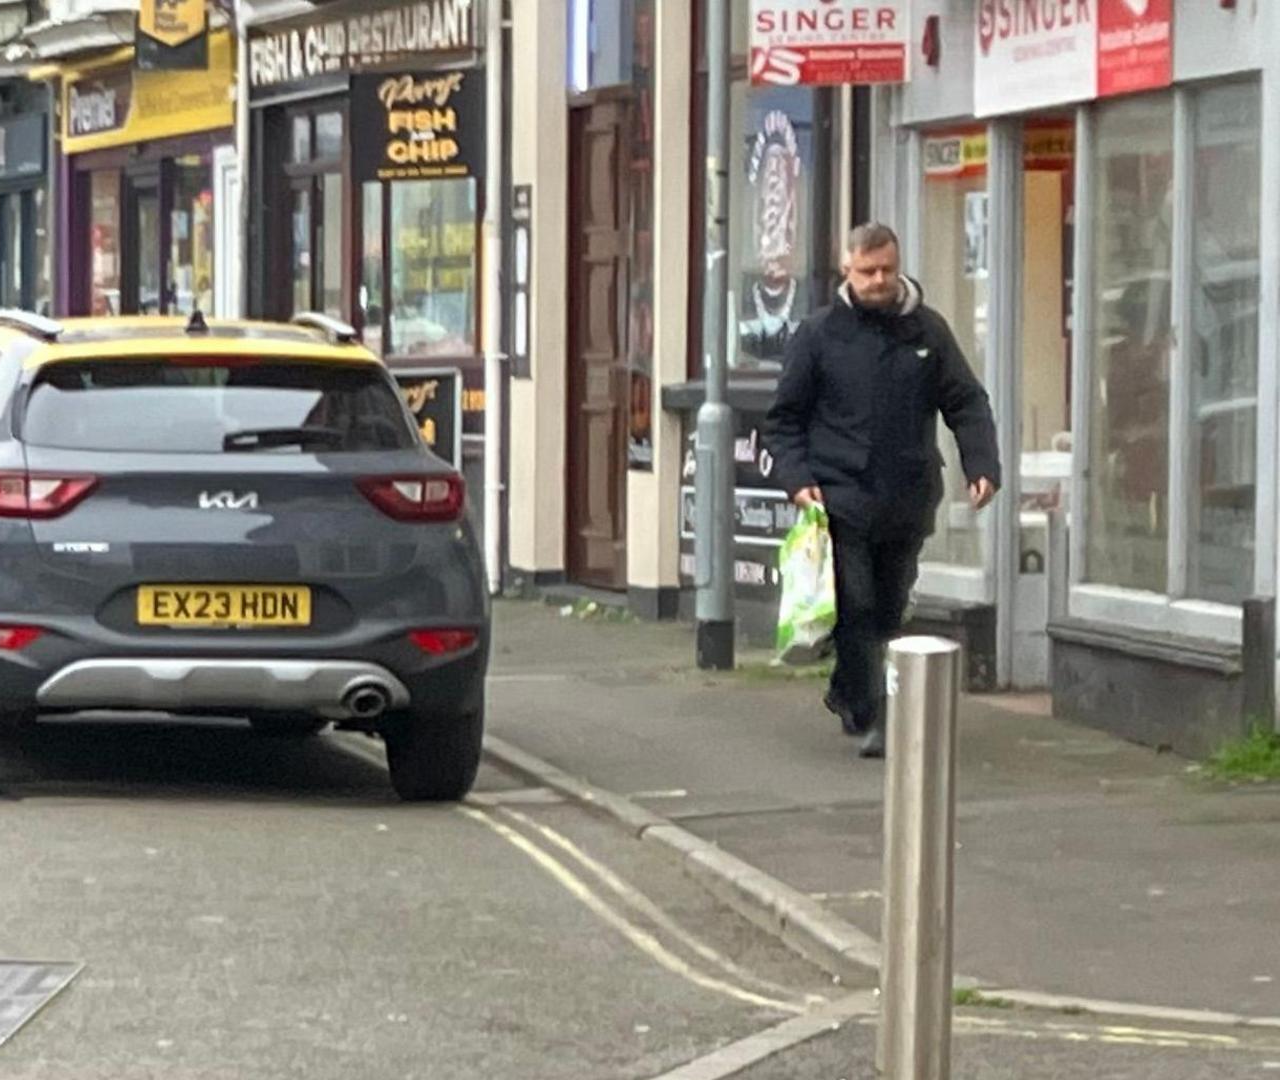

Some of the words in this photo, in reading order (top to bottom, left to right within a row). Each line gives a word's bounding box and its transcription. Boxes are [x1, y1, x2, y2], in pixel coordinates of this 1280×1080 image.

[756, 8, 896, 33] SINGER
[250, 33, 288, 87] FISH
[304, 23, 349, 77] CHIP
[348, 0, 471, 66] RESTAURANT
[388, 107, 457, 133] FISH
[386, 138, 459, 164] CHIP
[153, 591, 231, 619] EX23
[241, 592, 298, 620] HDN
